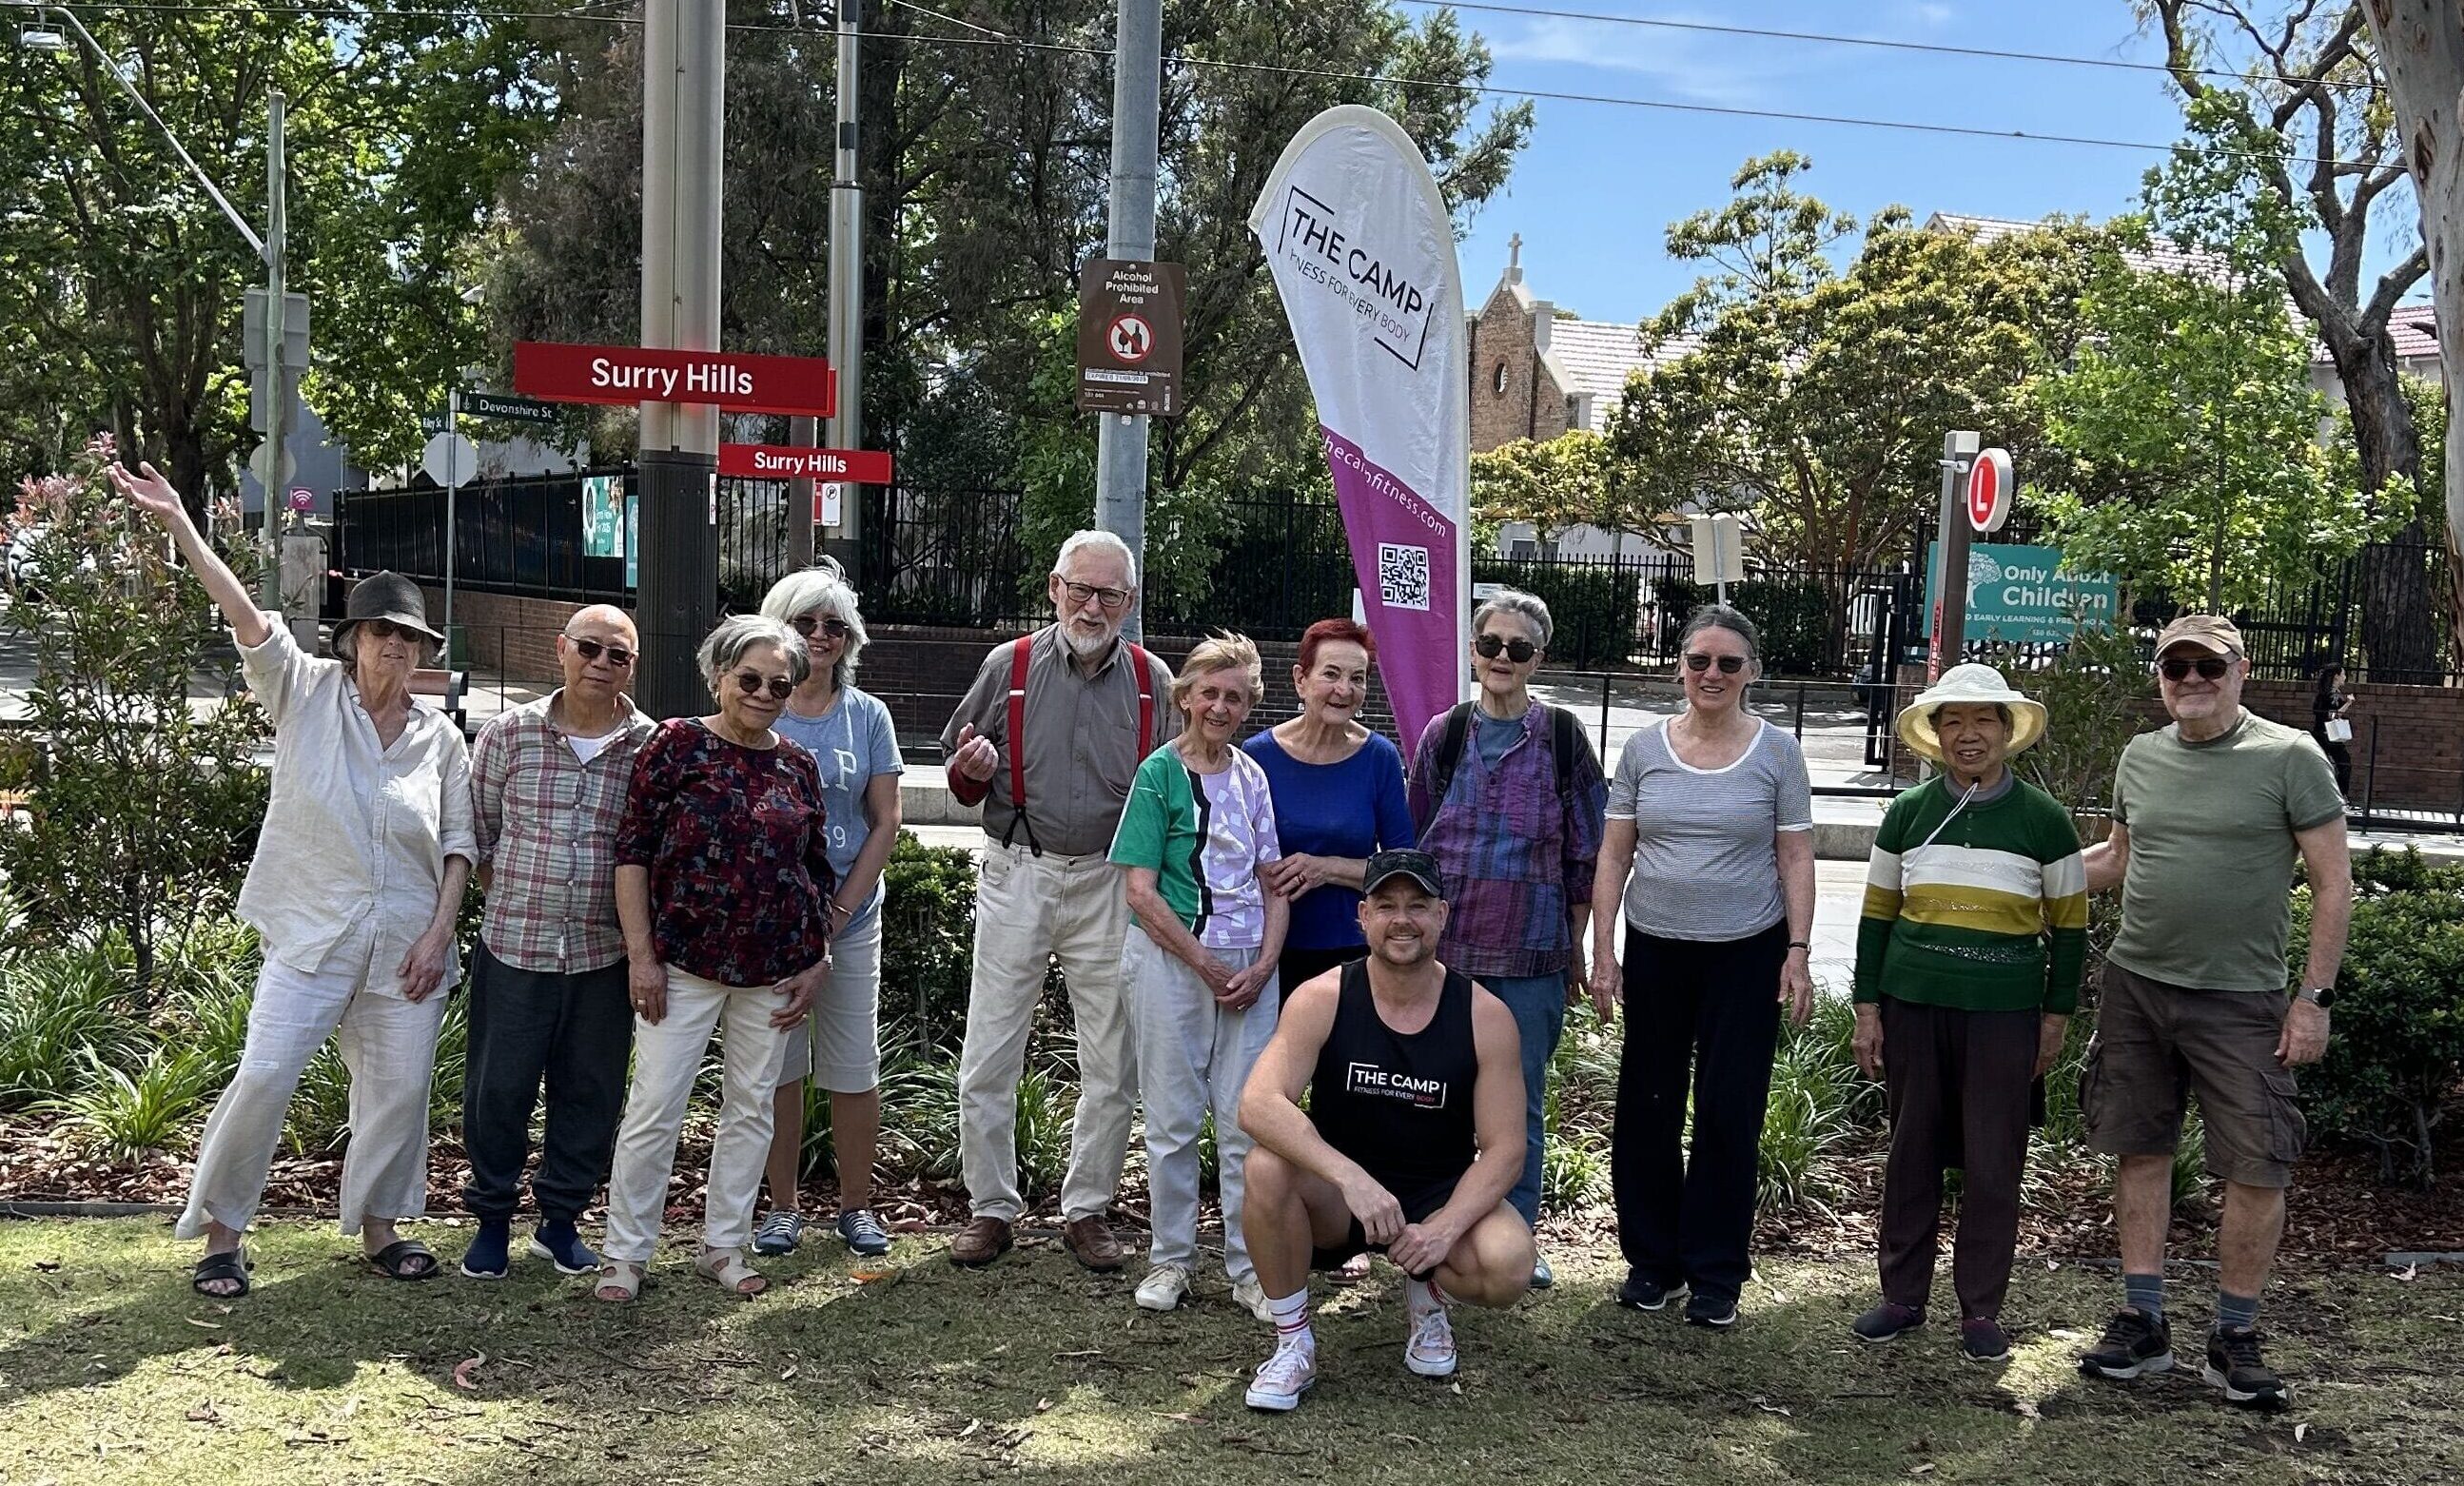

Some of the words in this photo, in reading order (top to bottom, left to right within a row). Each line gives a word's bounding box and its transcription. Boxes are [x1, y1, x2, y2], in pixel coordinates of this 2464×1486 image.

[1291, 206, 1345, 265] THE
[1348, 248, 1422, 315] CAMP
[1112, 270, 1152, 283] Alcohol
[1105, 281, 1159, 294] Prohibited
[1119, 293, 1144, 304] Area
[1327, 275, 1349, 300] FOR
[1380, 313, 1410, 342] BODY
[591, 358, 679, 398] Surry
[687, 363, 753, 396] Hills
[479, 399, 538, 418] Devonshire
[541, 407, 553, 419] St
[754, 451, 805, 475] Surry
[808, 454, 847, 474] Hills
[1976, 466, 1988, 512] L
[2004, 565, 2047, 584] Only
[2003, 615, 2046, 623] LEARNING
[1355, 1069, 1388, 1085] THE
[1391, 1073, 1440, 1093] CAMP
[1354, 1085, 1379, 1095] FITNESS
[1380, 1088, 1395, 1097] FOR
[1395, 1090, 1415, 1100] EVERY
